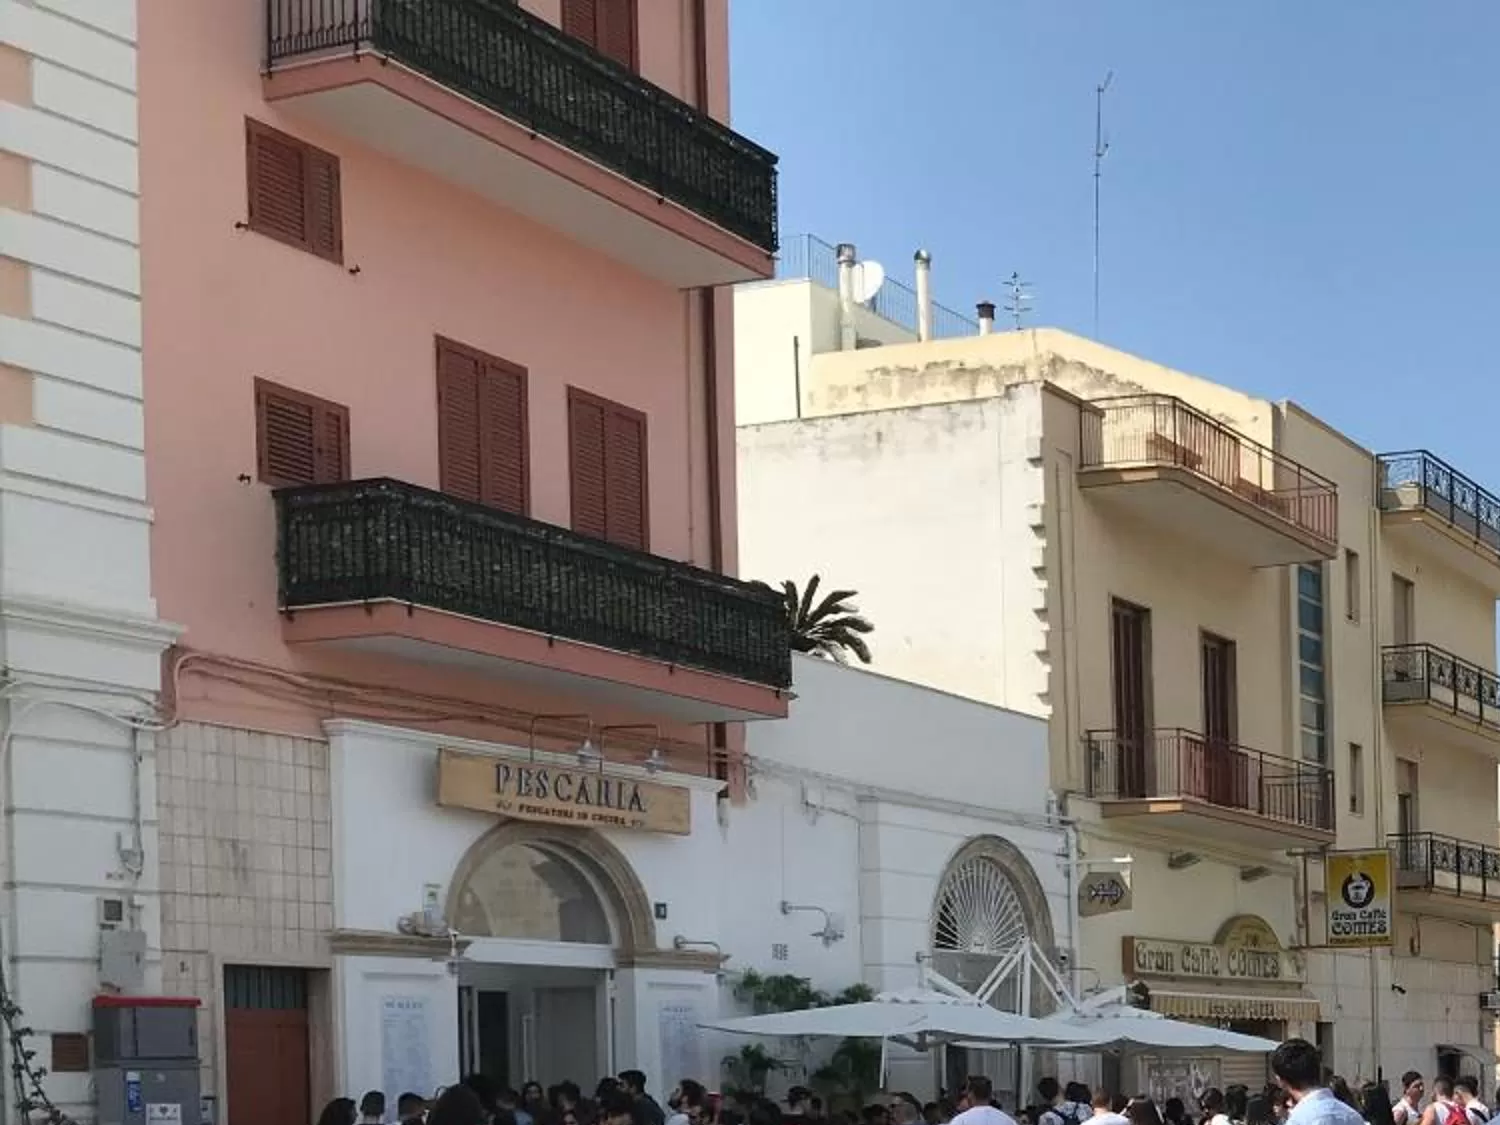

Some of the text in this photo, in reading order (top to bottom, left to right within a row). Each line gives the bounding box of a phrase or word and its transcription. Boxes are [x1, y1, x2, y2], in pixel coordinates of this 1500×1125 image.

[494, 763, 647, 813] PESCARIA
[1331, 909, 1356, 921] Gran
[1135, 943, 1174, 972] Gran
